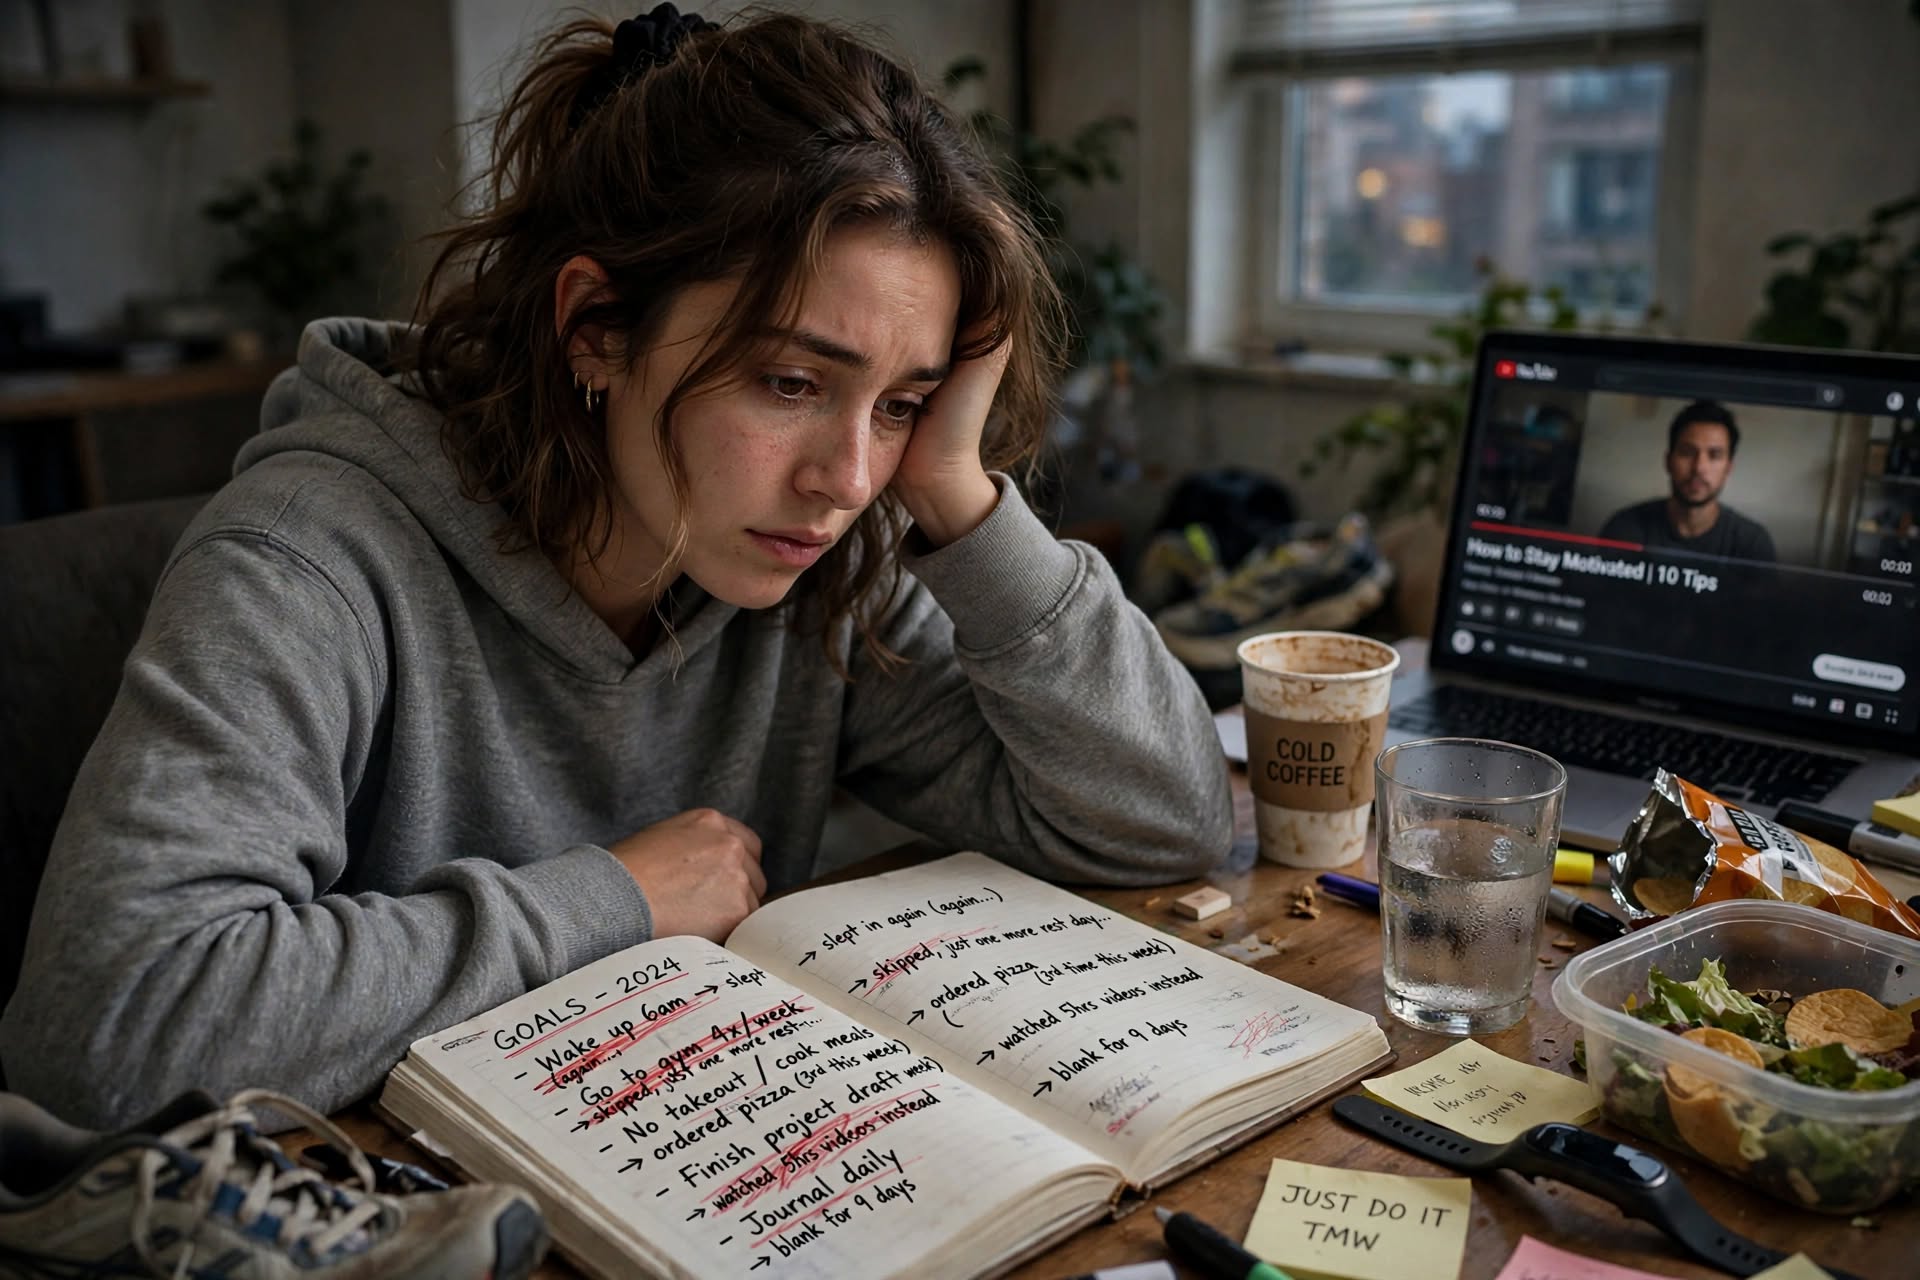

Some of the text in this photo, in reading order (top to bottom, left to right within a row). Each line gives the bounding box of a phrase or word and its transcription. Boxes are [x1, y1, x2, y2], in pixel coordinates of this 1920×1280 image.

[1466, 537, 1504, 561] How
[1504, 544, 1523, 563] to
[1524, 546, 1560, 572] Stay
[1562, 551, 1645, 581] Motivated
[1658, 565, 1679, 585] 10
[1682, 569, 1718, 593] Tips
[1267, 761, 1345, 786] COFFEE
[1277, 738, 1335, 762] COLD
[821, 887, 1004, 951] slept in again (again...)
[872, 913, 1112, 982] skipped, just one more rest day...
[930, 971, 990, 1009] ordered
[994, 962, 1038, 985] pizza
[1034, 937, 1176, 985] (3rd time this week)
[494, 998, 586, 1050] GOALS
[616, 957, 682, 994] 2024
[535, 968, 766, 1072] Wake up 6am slept
[998, 1009, 1062, 1051] watched
[1063, 1000, 1098, 1019] 5hrs
[1148, 967, 1203, 993] instead
[580, 1000, 804, 1106] Go to gym 4x/week
[593, 1082, 660, 1123] skipped,
[700, 1053, 724, 1070] one
[729, 1036, 766, 1056] more
[622, 1121, 659, 1144] No
[665, 1072, 747, 1120] takeout
[776, 1042, 820, 1070] cook
[824, 1027, 874, 1050] meals
[1048, 1016, 1188, 1082] blank for 9 days
[653, 1039, 911, 1160] ordered pizza (3rd this week)
[679, 1056, 944, 1188] Finish project draft week)
[712, 1089, 941, 1211] watched 5hrs videos instead
[739, 1149, 905, 1235] Journal daily
[769, 1177, 916, 1258] blank for 9 days
[1282, 1184, 1452, 1228] JUST DO IT
[1303, 1221, 1380, 1251] TMW
